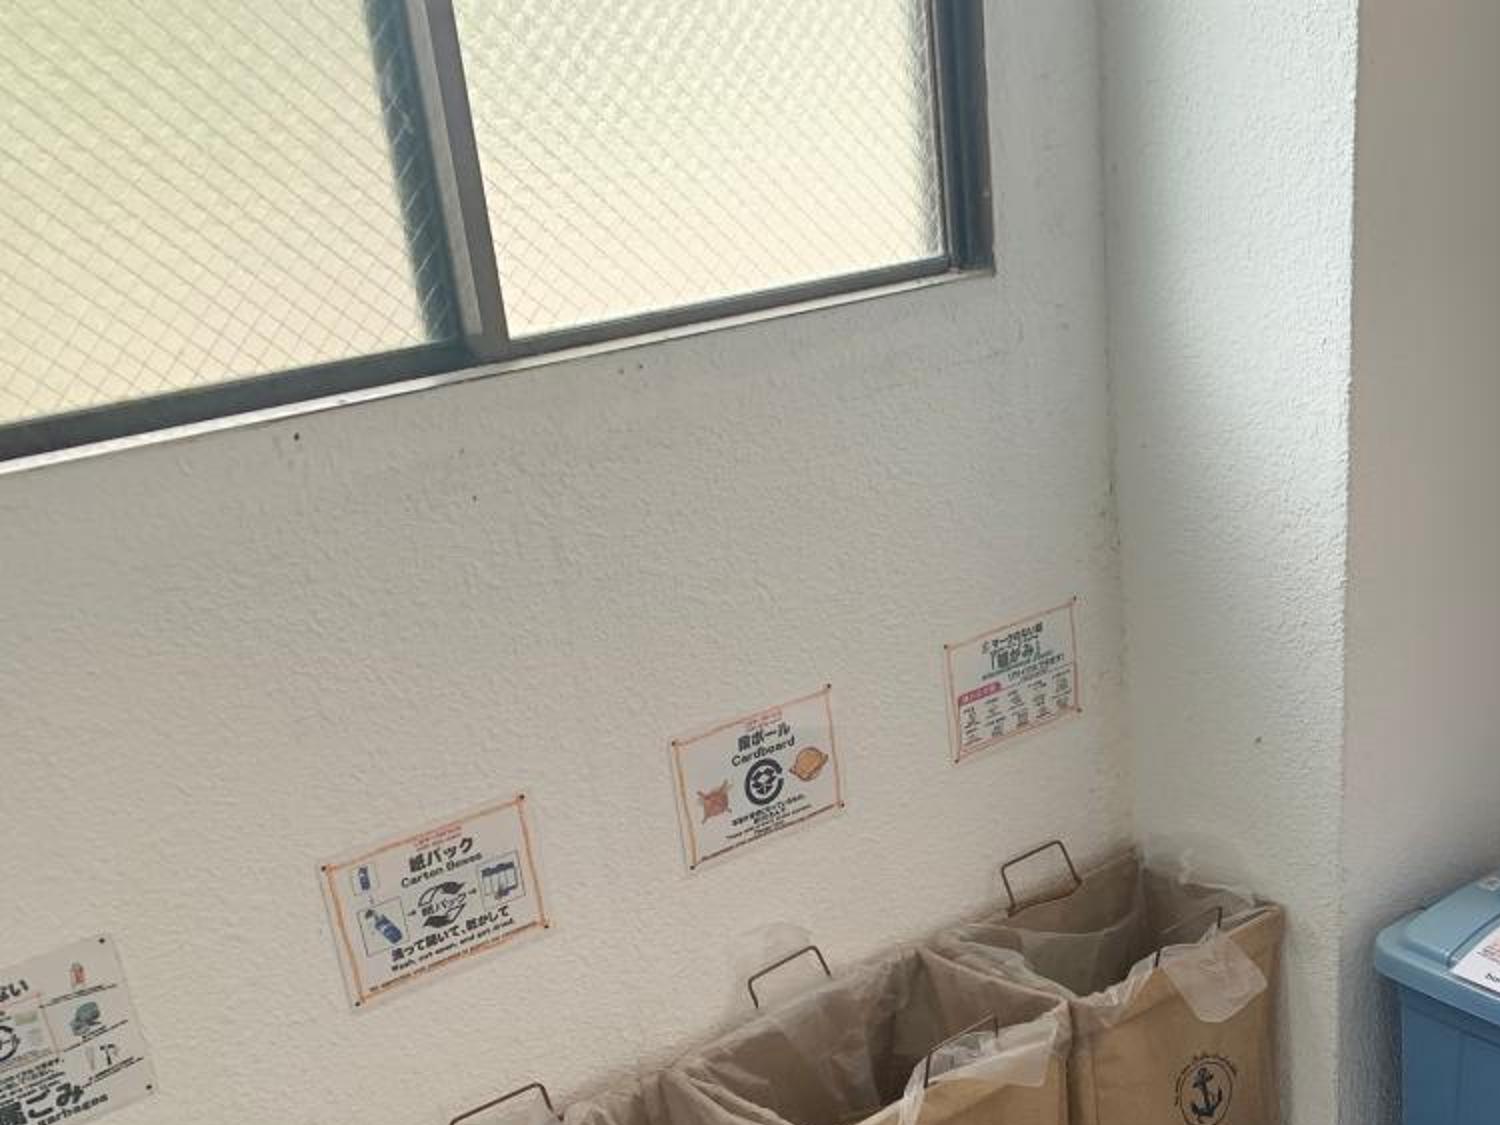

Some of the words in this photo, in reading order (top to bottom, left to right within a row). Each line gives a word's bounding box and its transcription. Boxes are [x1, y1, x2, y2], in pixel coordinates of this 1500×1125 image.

[732, 736, 795, 767] Cardboard
[408, 837, 473, 872] 紙パック
[401, 865, 443, 888] Carton
